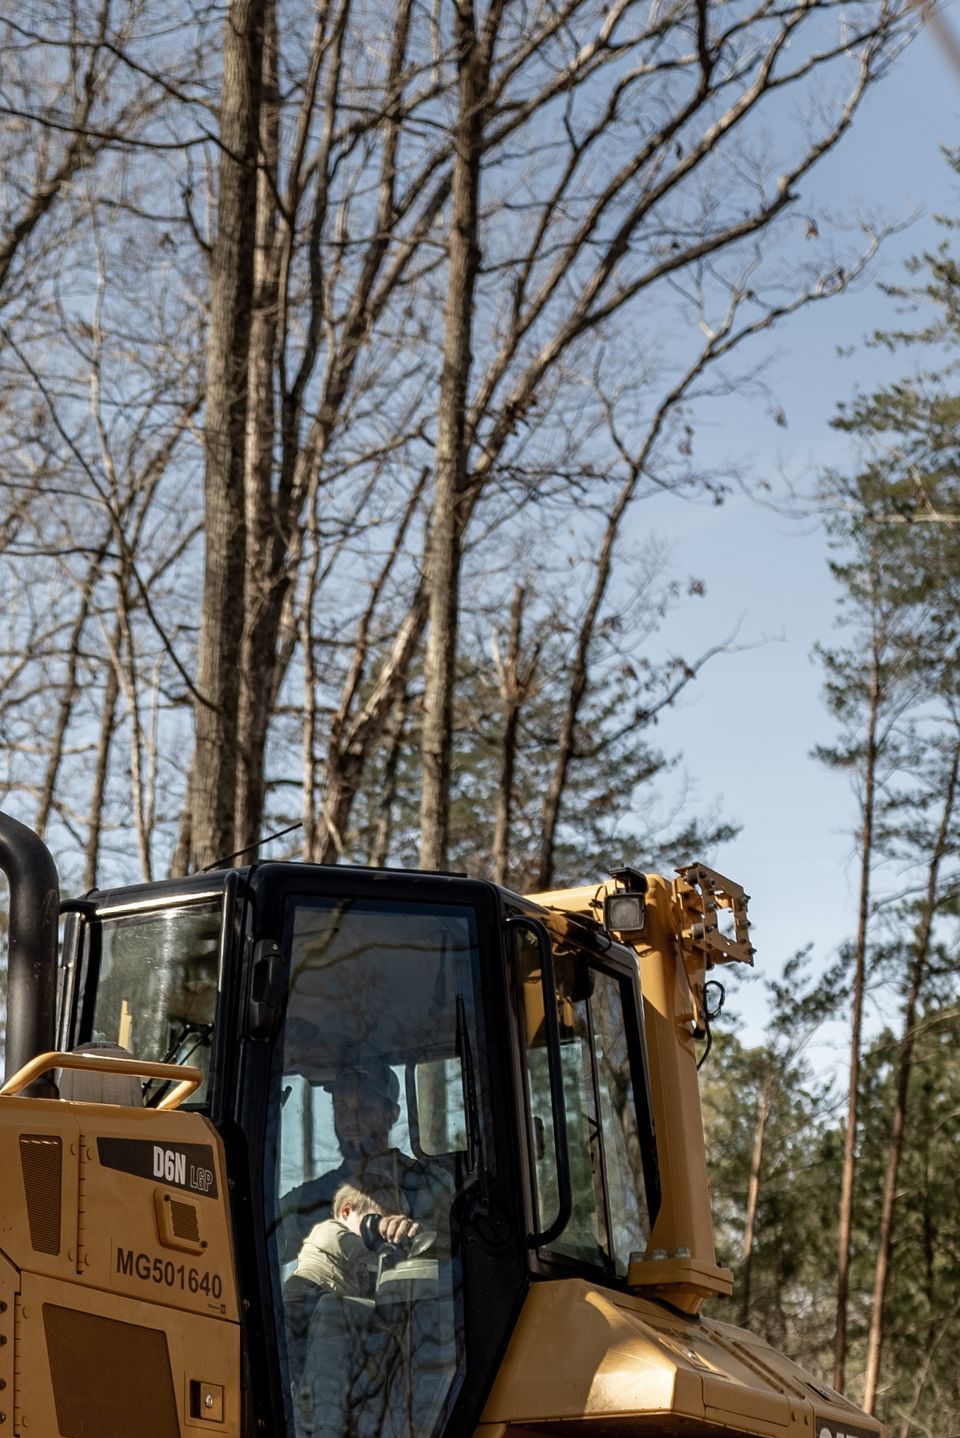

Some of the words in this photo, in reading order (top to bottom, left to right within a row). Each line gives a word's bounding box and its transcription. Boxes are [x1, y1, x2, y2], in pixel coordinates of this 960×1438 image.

[153, 1145, 187, 1186] D6N
[189, 1165, 214, 1192] LGP
[117, 1247, 222, 1300] MG501640
